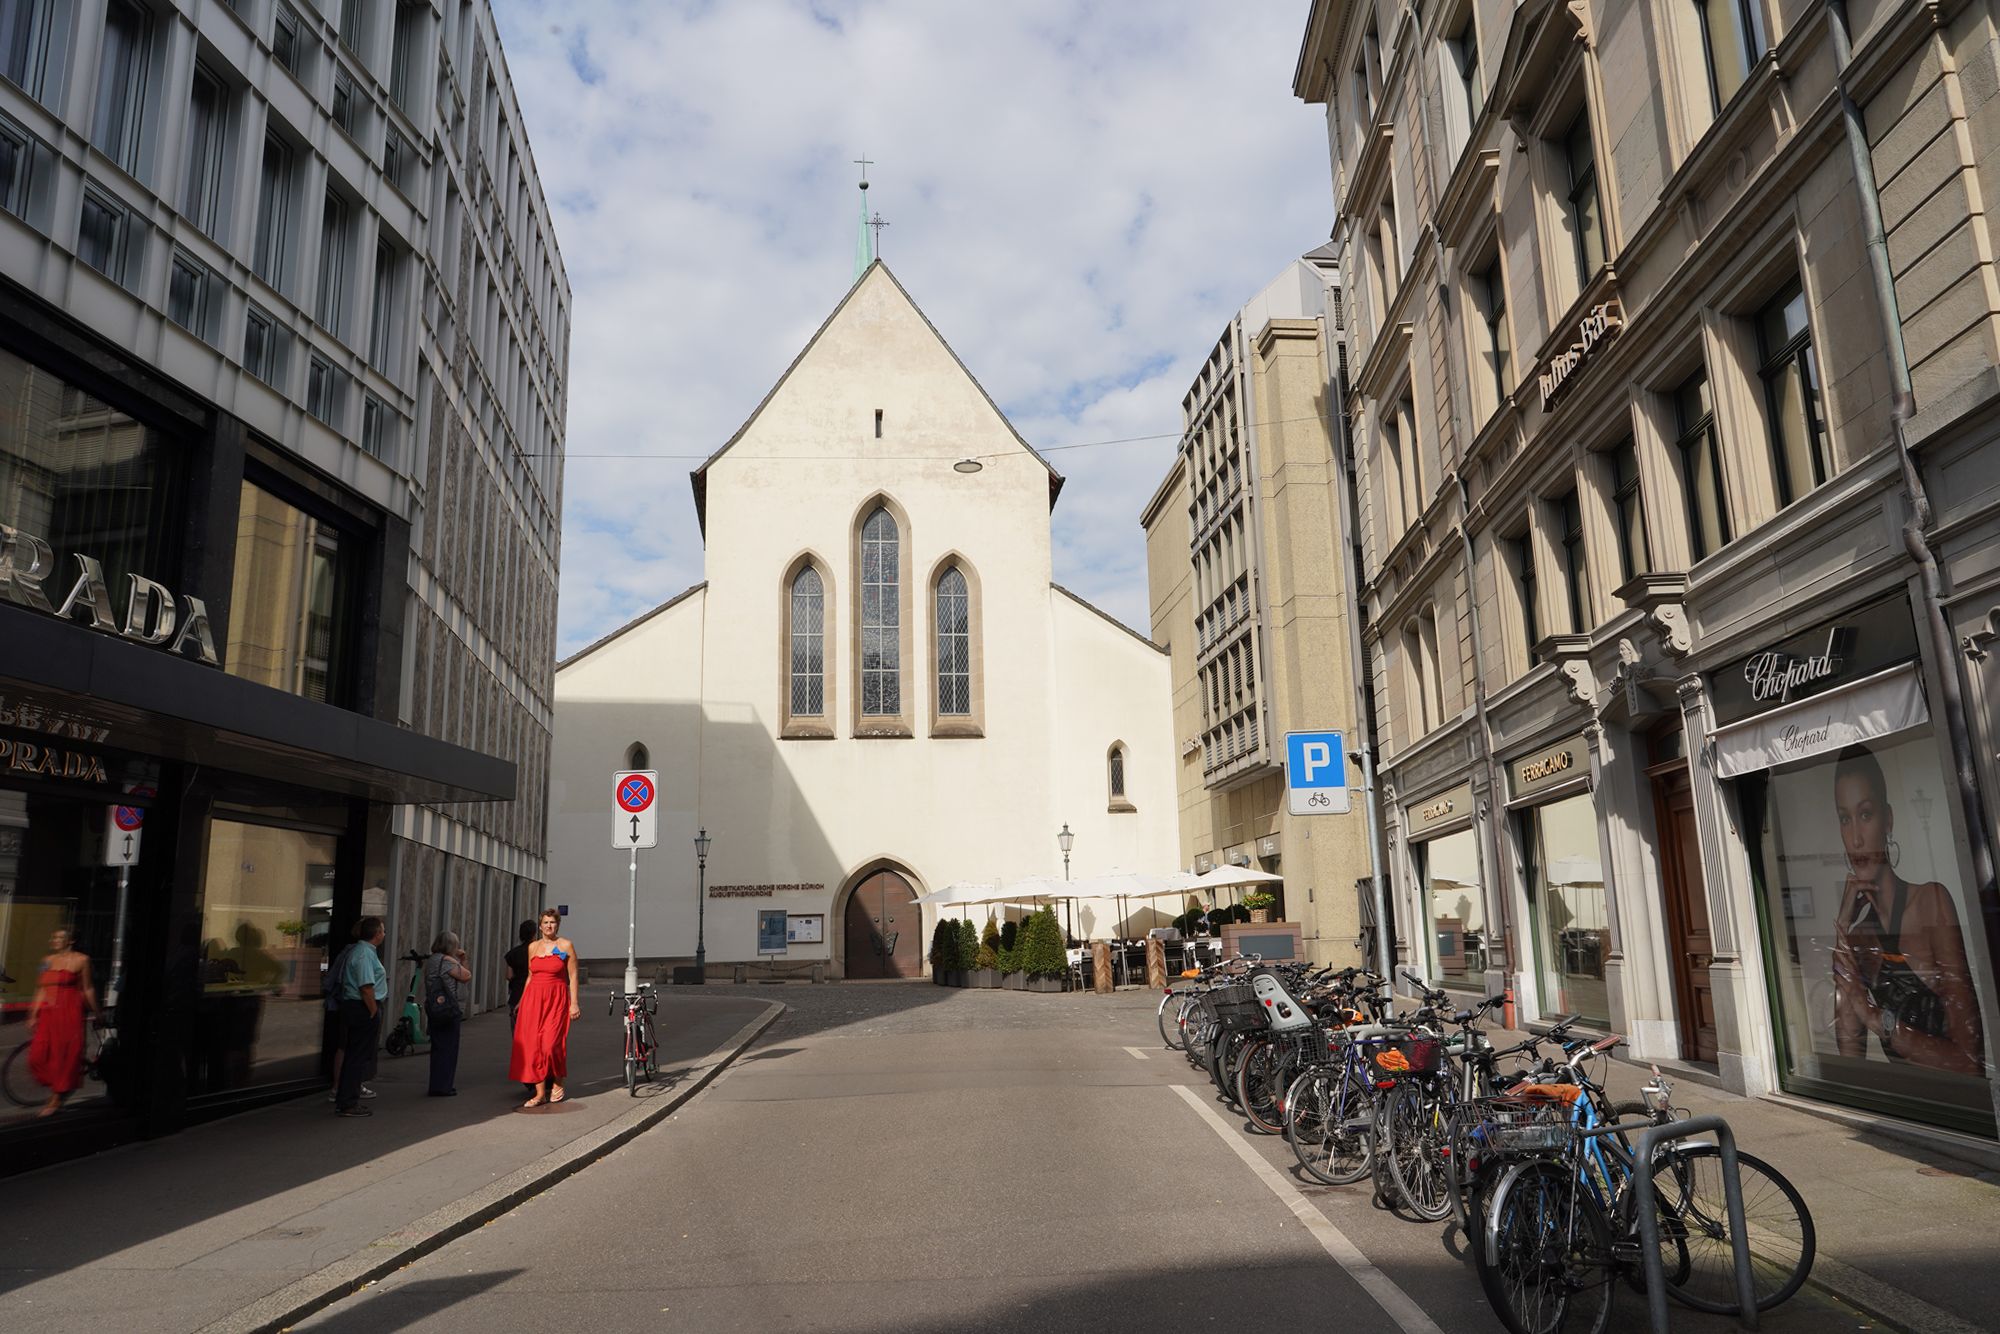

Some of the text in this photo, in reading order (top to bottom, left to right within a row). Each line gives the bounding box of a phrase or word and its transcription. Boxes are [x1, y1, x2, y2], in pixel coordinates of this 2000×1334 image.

[1745, 627, 1835, 703] Chopard
[1780, 715, 1831, 753] Chopard
[1303, 742, 1330, 782] P
[1522, 752, 1568, 783] FERRAGAMO
[801, 882, 824, 890] ZÜRICH
